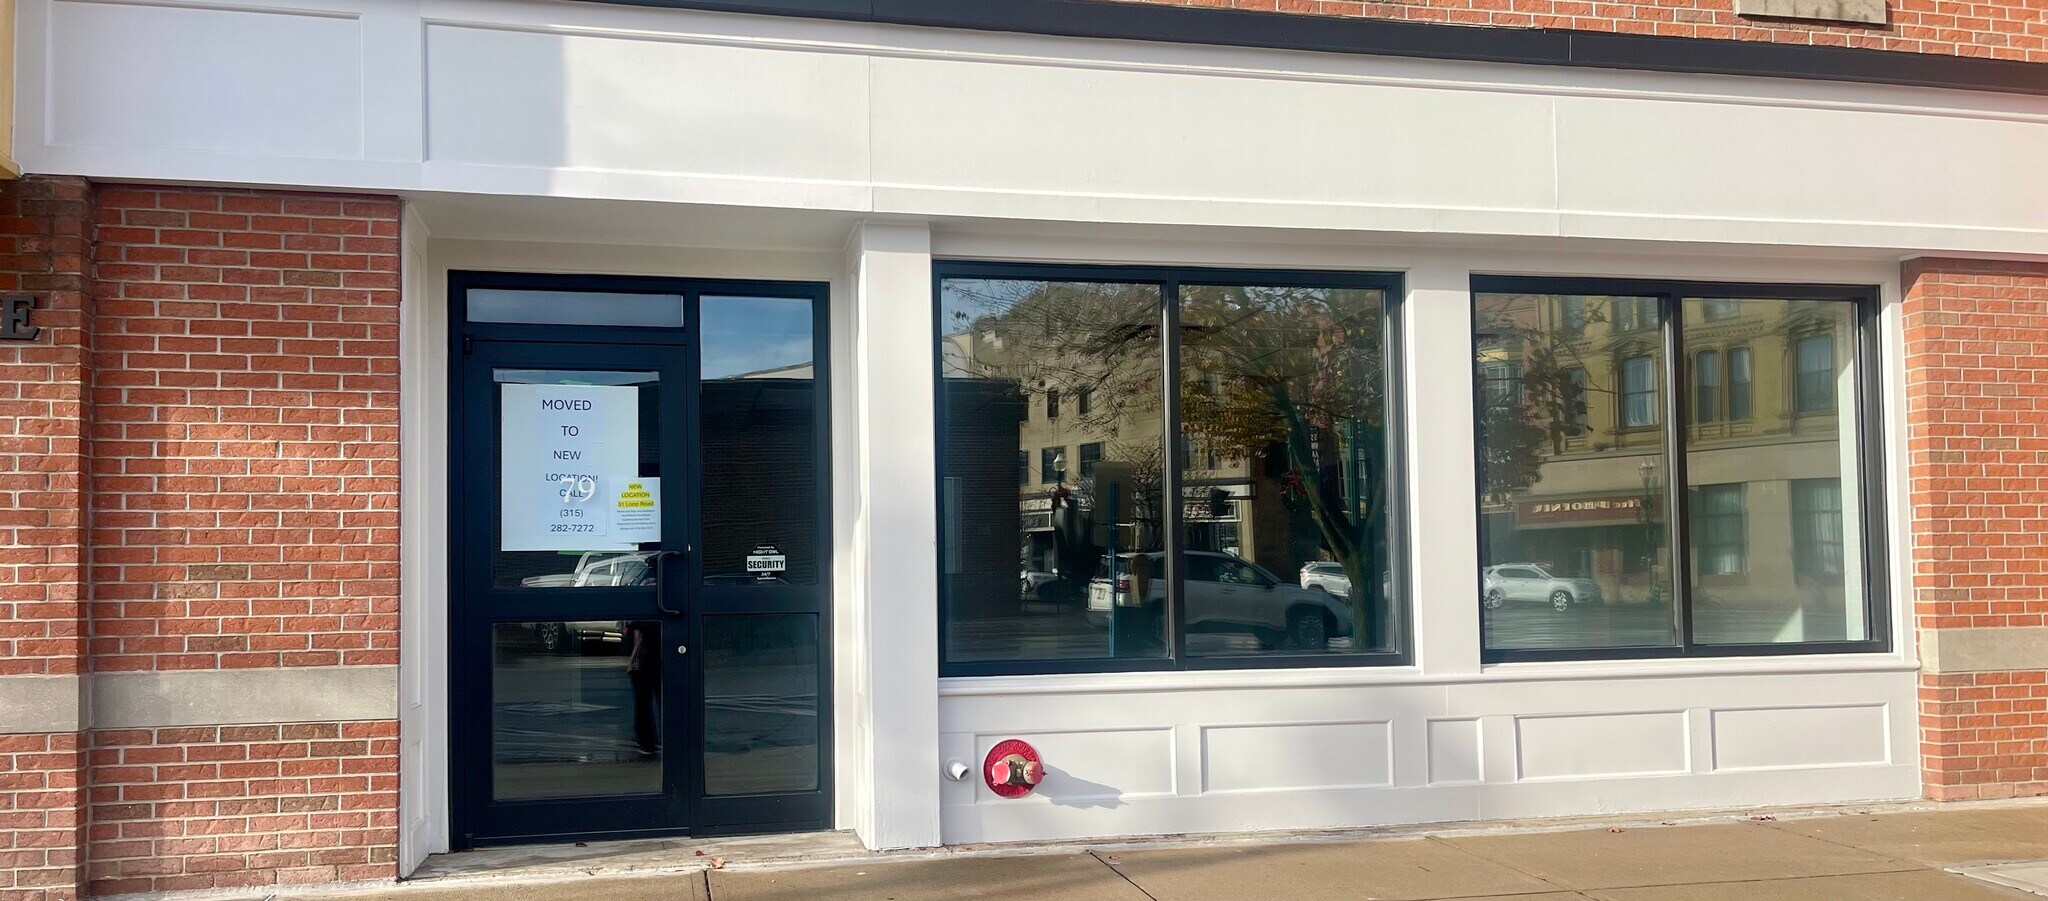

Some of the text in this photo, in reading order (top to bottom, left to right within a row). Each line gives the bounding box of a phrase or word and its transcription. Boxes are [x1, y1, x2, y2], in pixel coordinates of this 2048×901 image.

[542, 399, 592, 411] MOVED
[561, 425, 579, 437] TO
[553, 450, 582, 460] NEW
[545, 473, 598, 483] LOCATION!
[560, 477, 596, 503] 79
[560, 508, 584, 518] (315)
[550, 524, 595, 533] 282-7272
[748, 560, 784, 569] SECURITY
